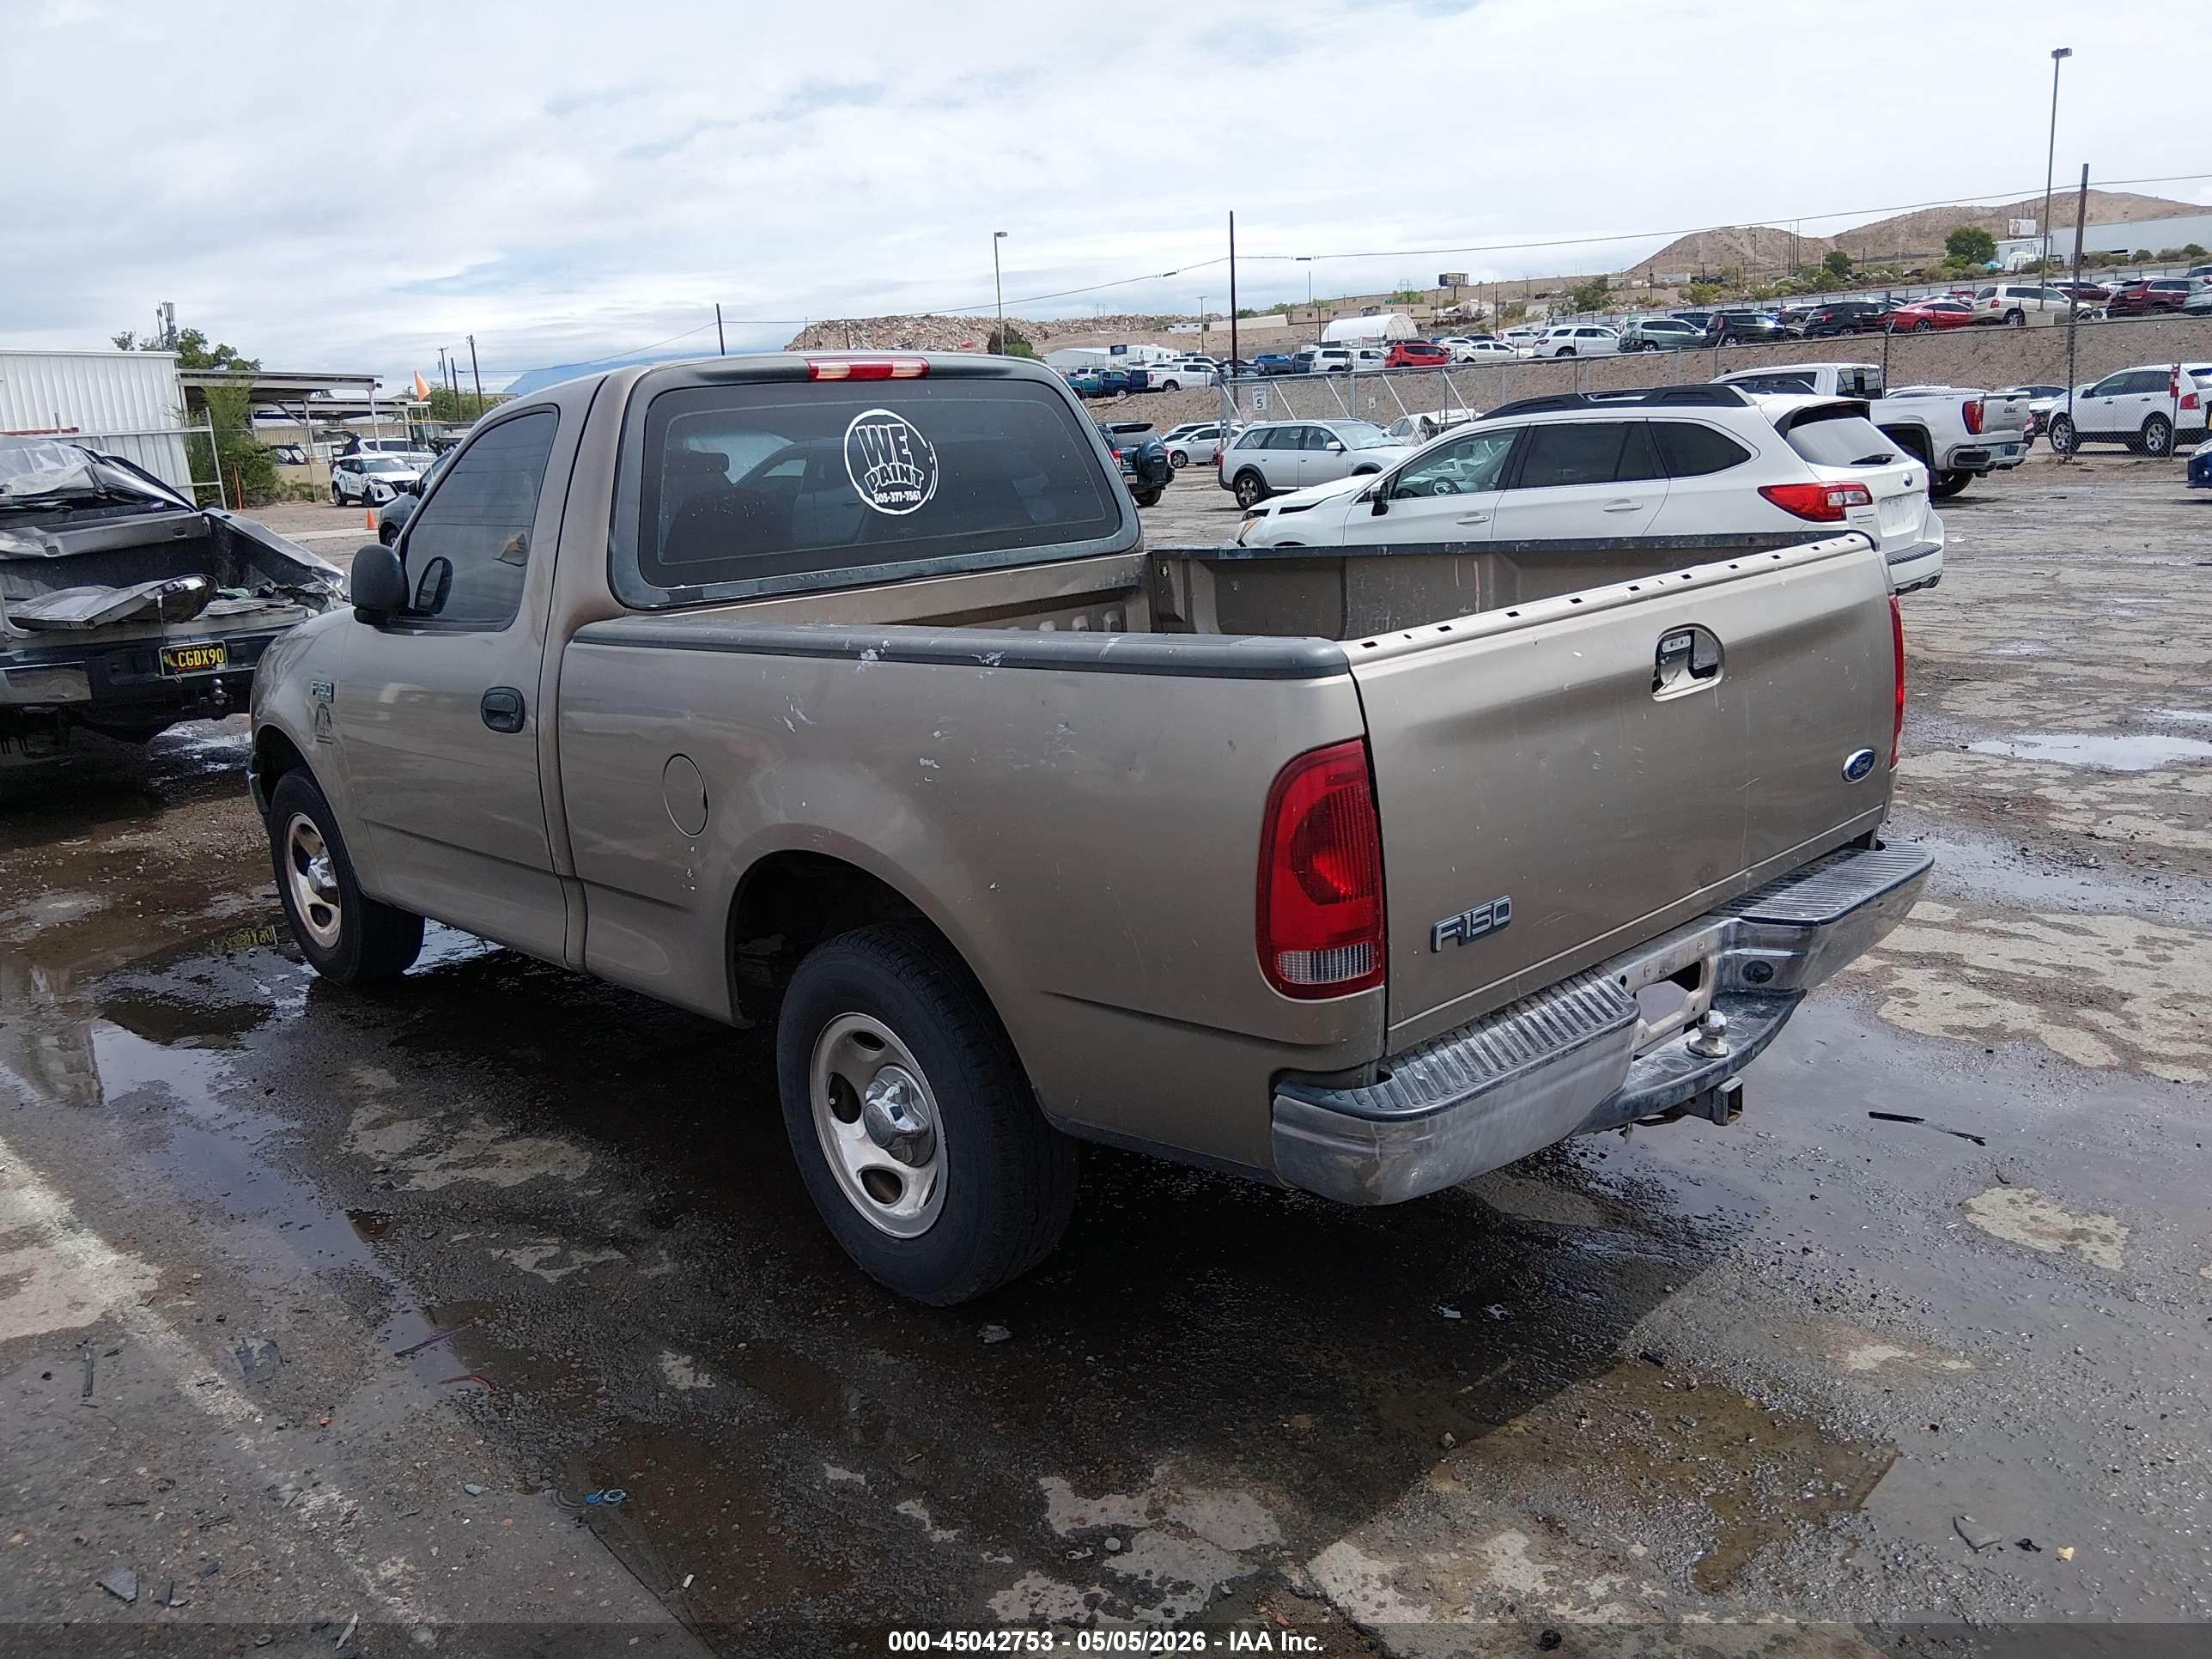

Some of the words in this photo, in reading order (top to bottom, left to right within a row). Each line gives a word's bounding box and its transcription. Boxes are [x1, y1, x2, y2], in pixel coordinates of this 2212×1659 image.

[1256, 398, 1263, 409] 5
[854, 423, 914, 469] WE
[864, 463, 925, 494] PAINT
[178, 648, 224, 667] CGDX90
